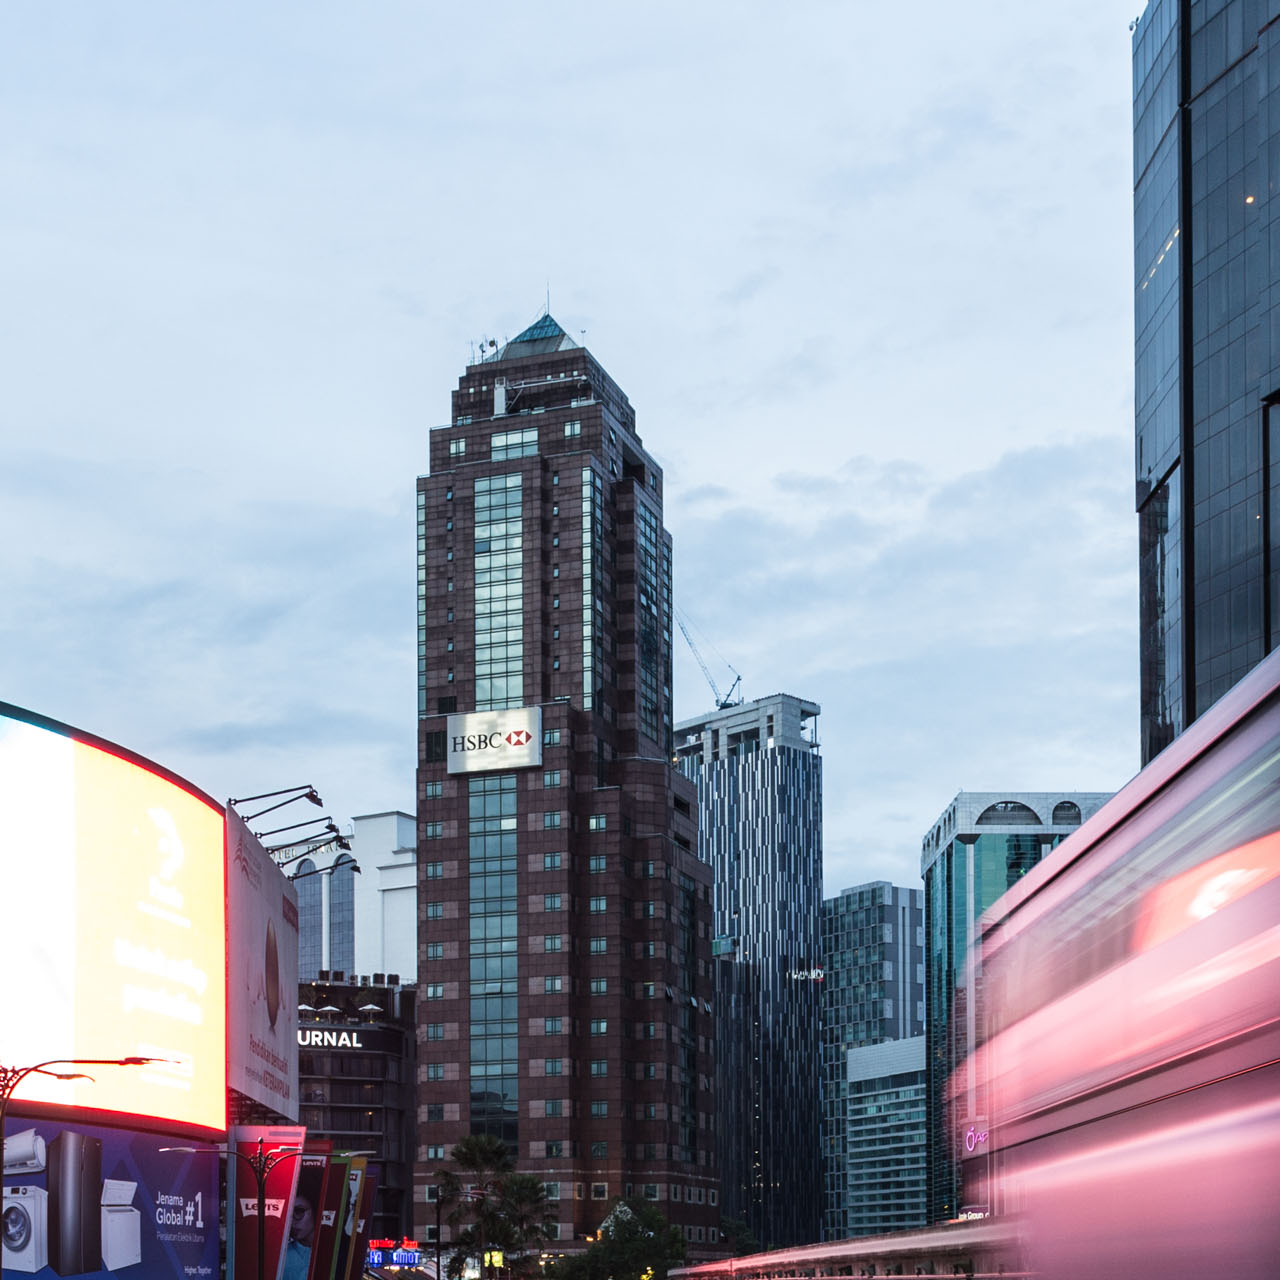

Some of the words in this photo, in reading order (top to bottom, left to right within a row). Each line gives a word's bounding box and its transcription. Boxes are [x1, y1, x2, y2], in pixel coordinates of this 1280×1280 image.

[451, 731, 502, 753] HSBC
[156, 1191, 184, 1206] Jenama
[156, 1208, 184, 1226] Global
